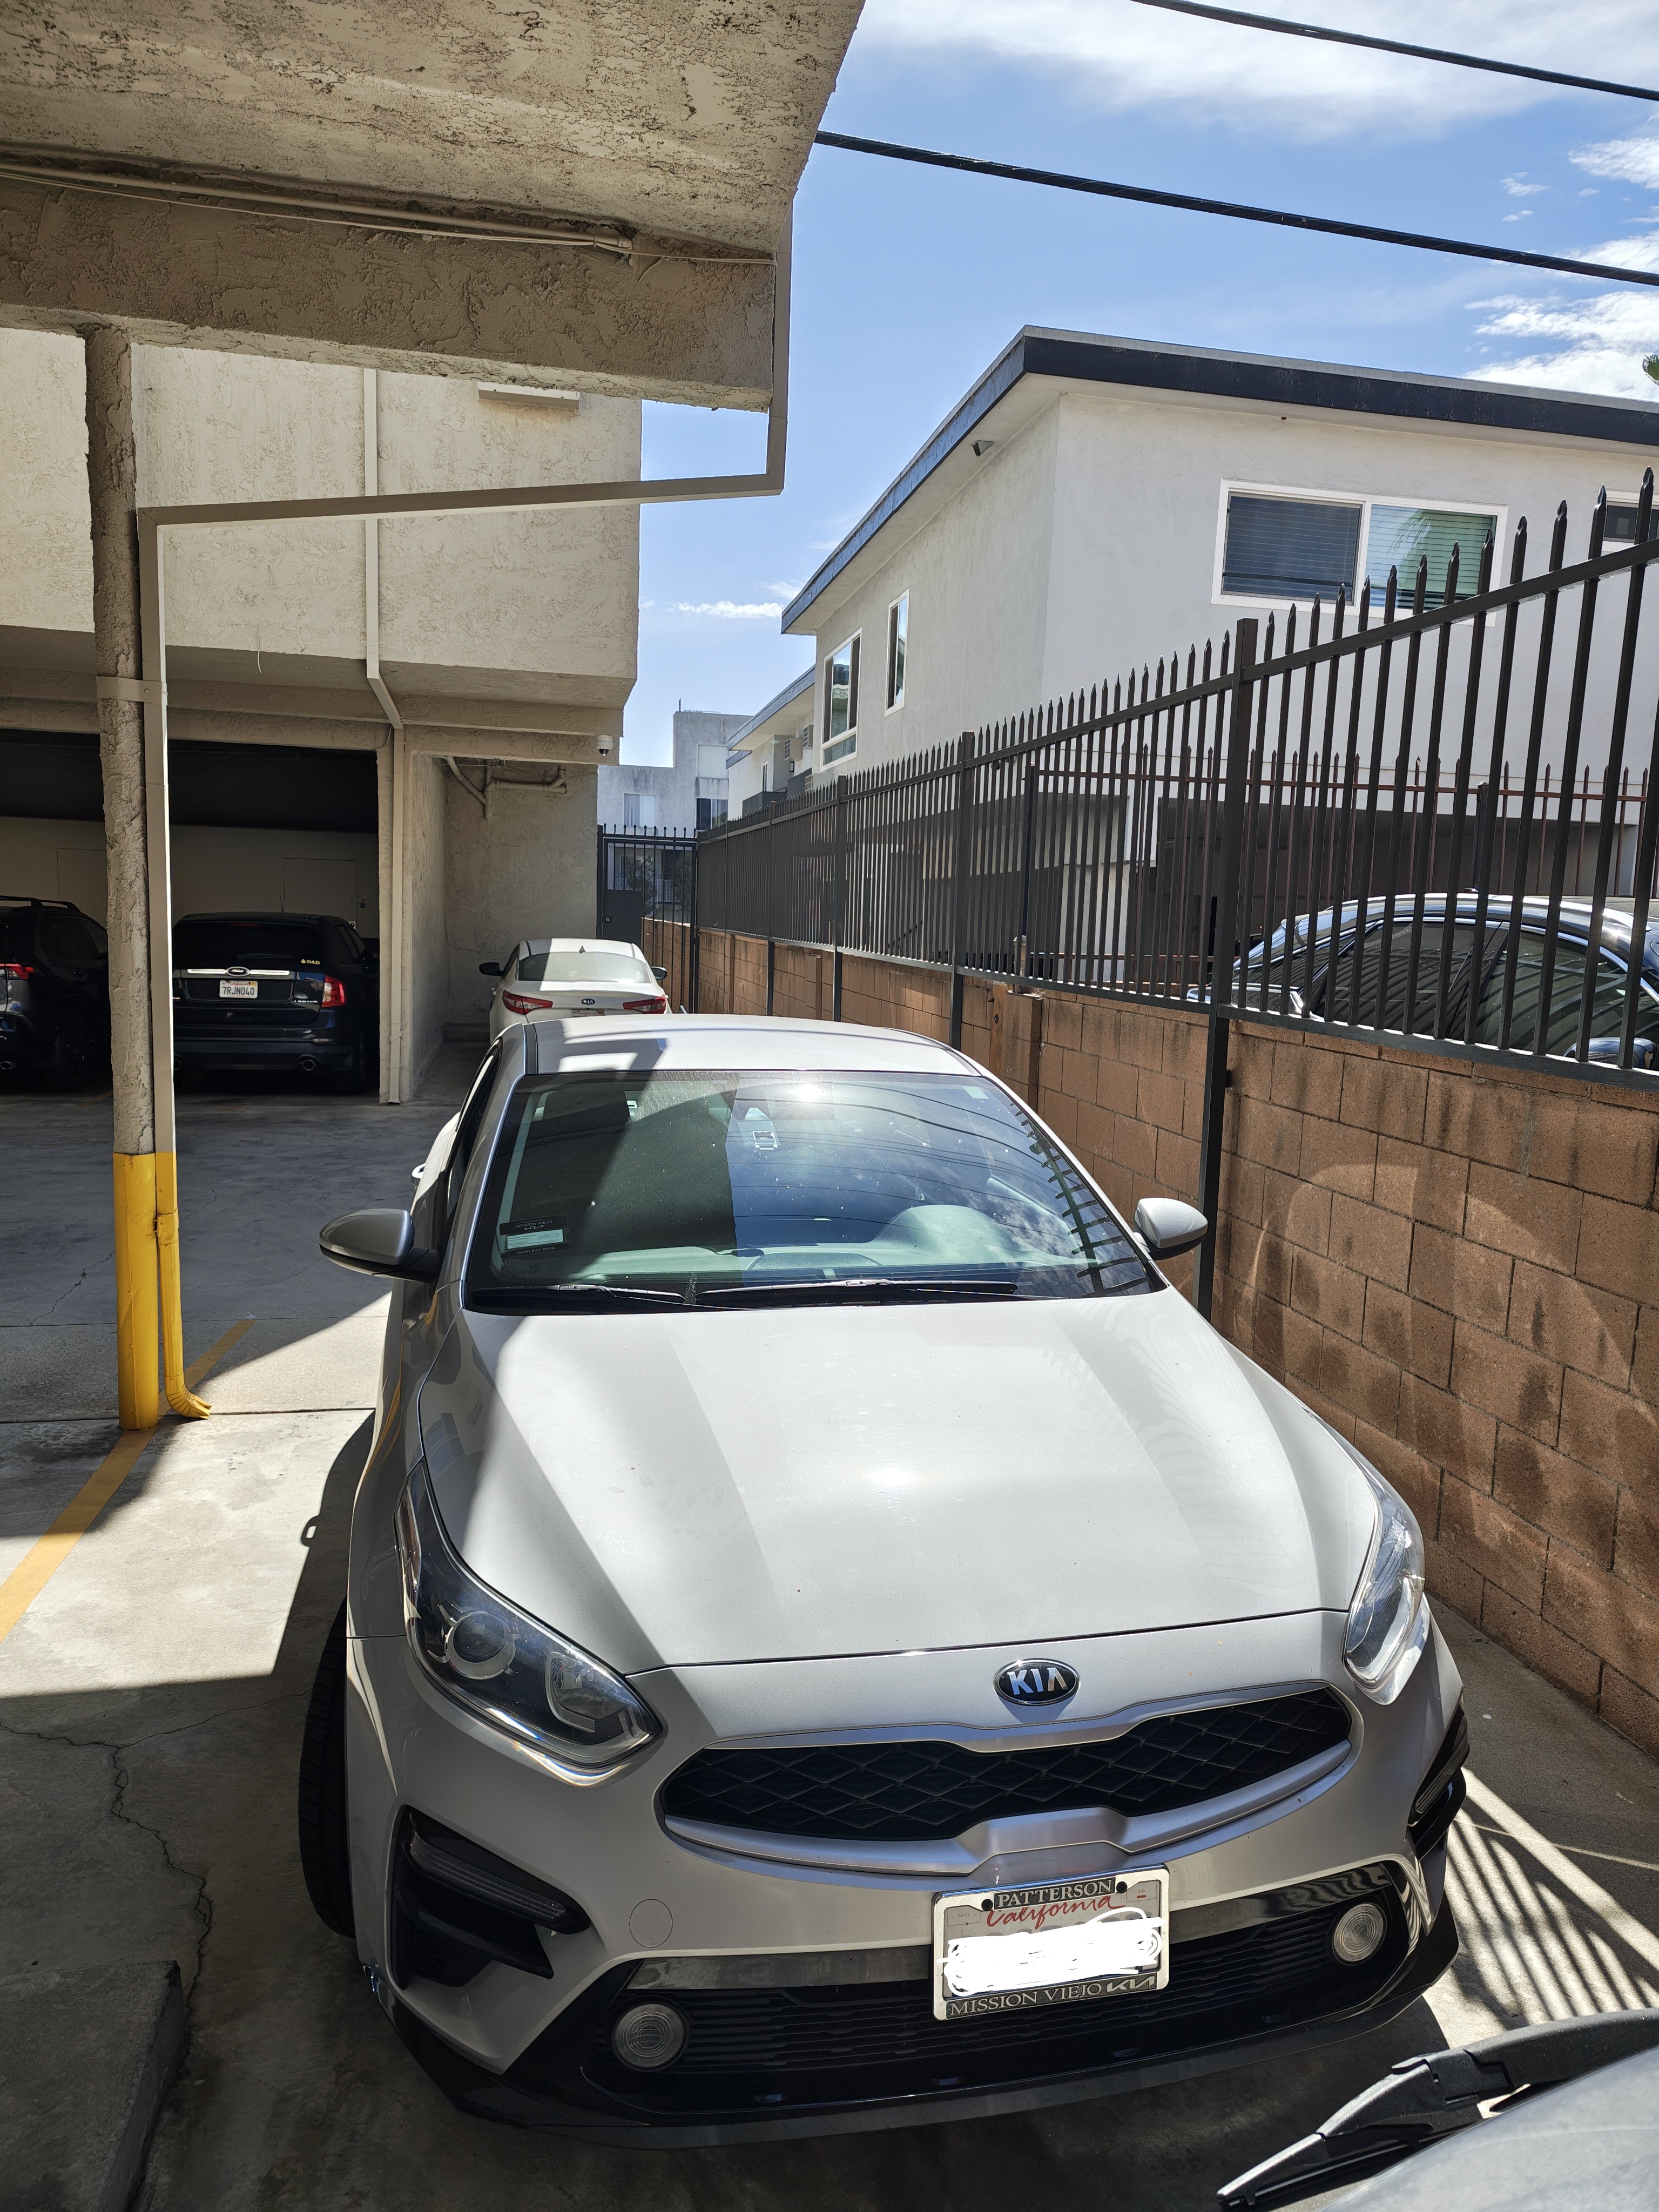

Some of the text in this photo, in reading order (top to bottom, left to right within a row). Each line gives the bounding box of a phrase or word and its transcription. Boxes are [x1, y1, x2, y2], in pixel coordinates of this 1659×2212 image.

[222, 986, 255, 996] 7RJN040
[1007, 1667, 1068, 1695] KIA
[997, 1879, 1112, 1908] PATTERSON
[986, 1895, 1126, 1930] California
[950, 1975, 1156, 2016] MISSION VIEJO KIA
